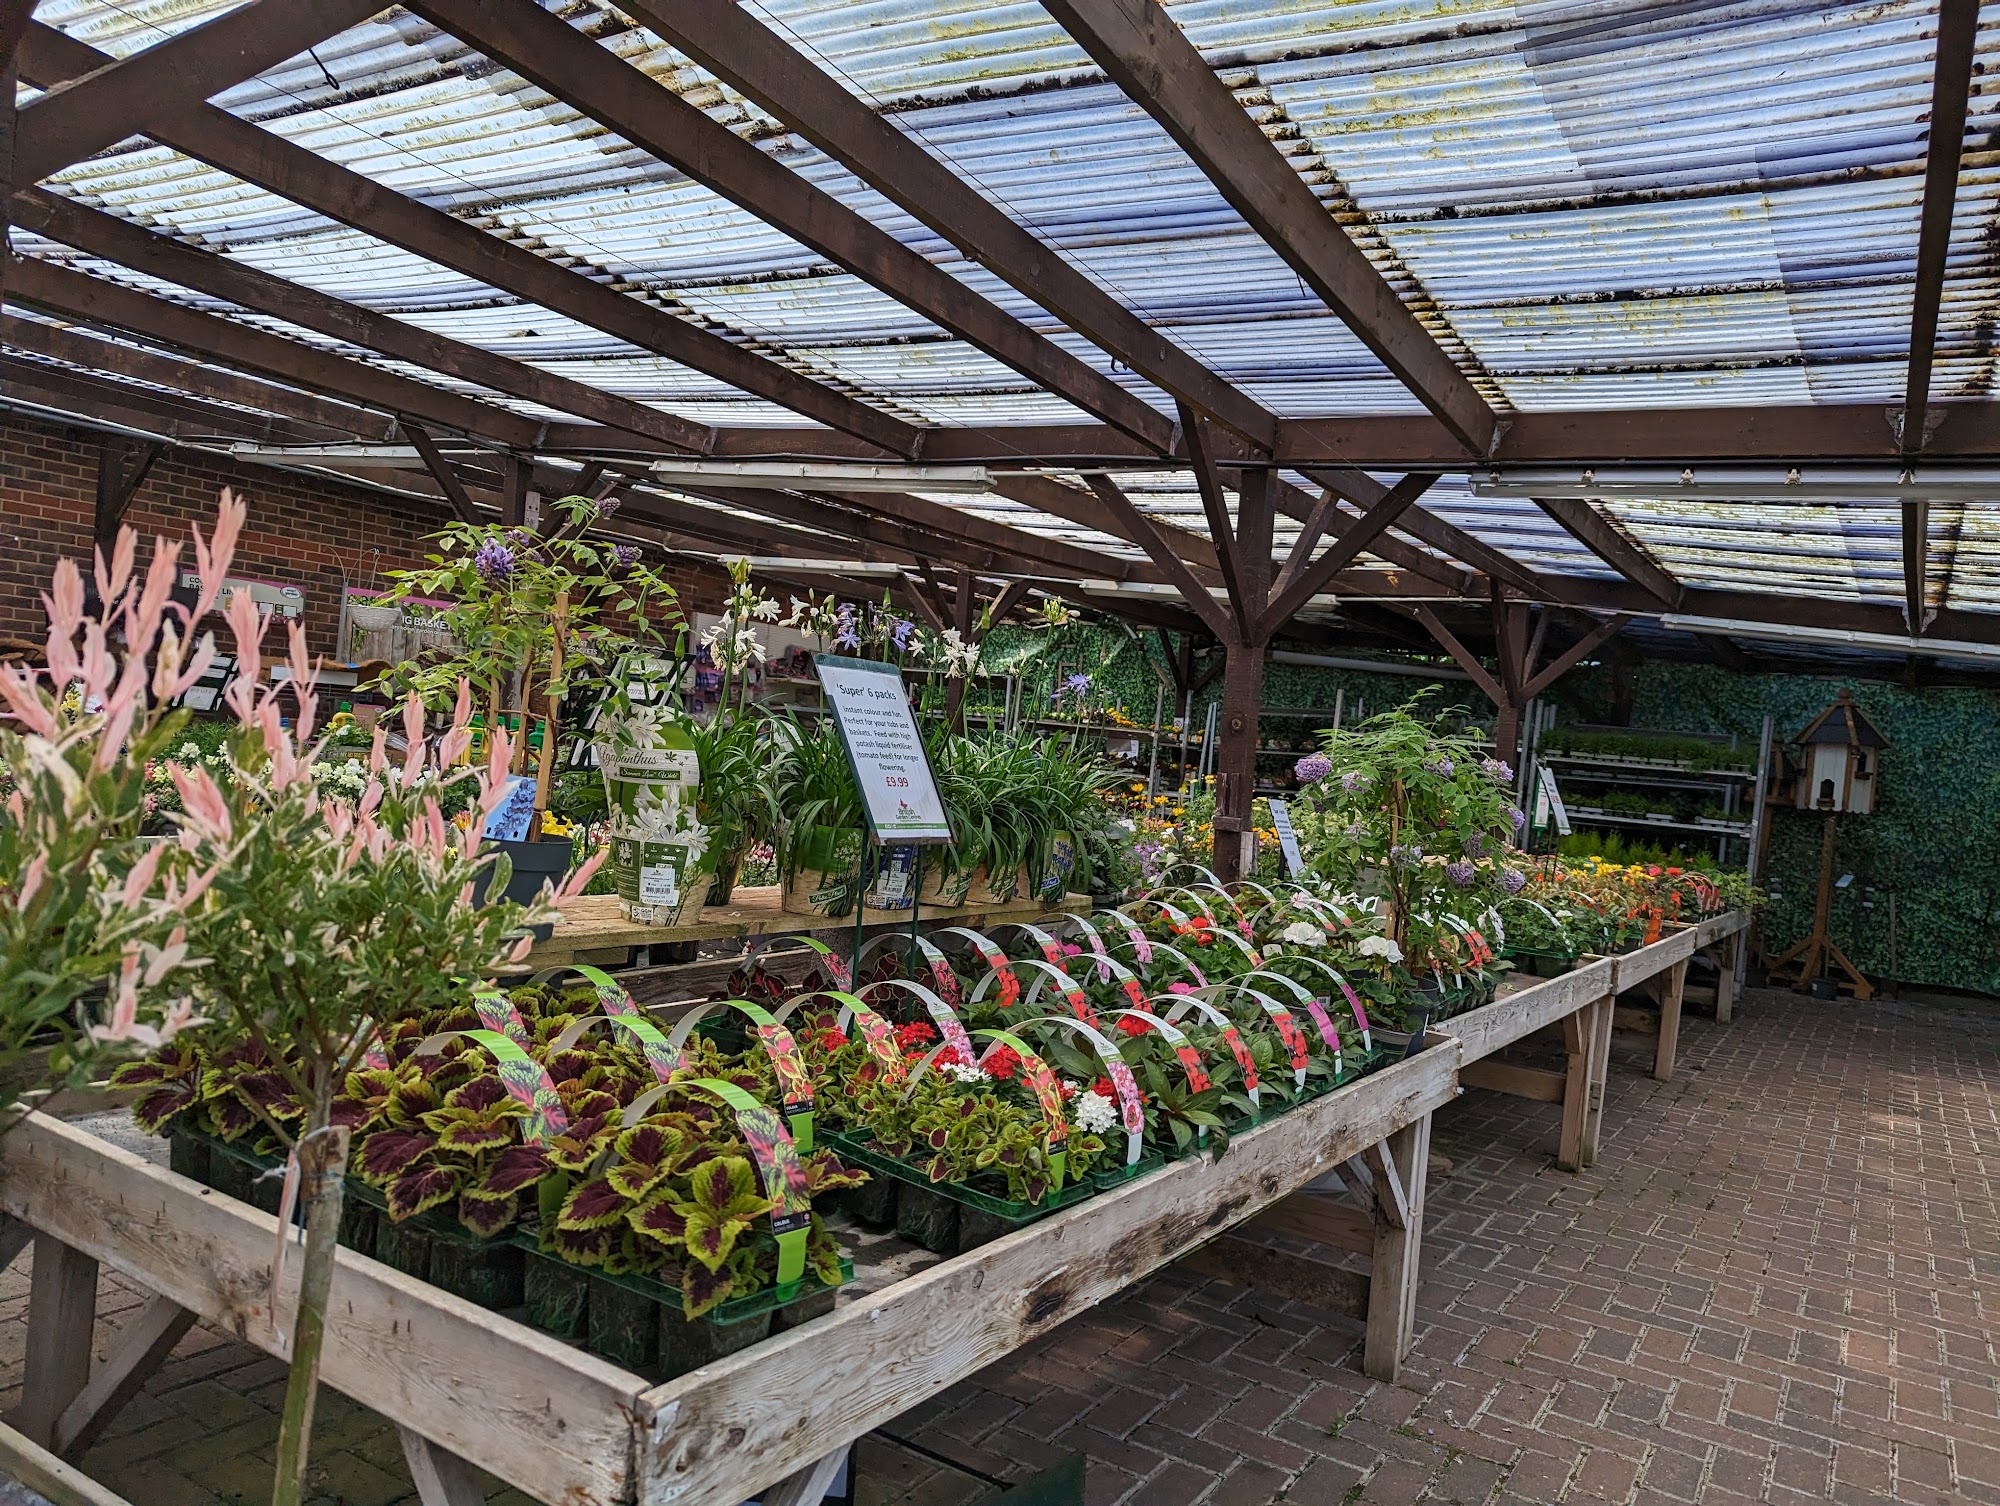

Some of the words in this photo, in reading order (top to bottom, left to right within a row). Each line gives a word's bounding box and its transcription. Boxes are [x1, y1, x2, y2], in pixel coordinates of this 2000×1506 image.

[837, 683, 864, 697] 'Super'
[867, 688, 873, 697] 6
[875, 690, 896, 700] packs
[843, 706, 863, 714] Instant
[864, 707, 880, 715] colour
[844, 716, 864, 725] Perfect
[865, 718, 873, 726] for
[874, 720, 886, 728] your
[887, 720, 899, 728] tubs
[848, 728, 872, 737] baskets.
[874, 730, 888, 738] Feed
[888, 731, 900, 739] with
[901, 731, 912, 740] high
[856, 740, 875, 748] potash
[875, 740, 891, 750] liquid
[856, 750, 879, 759] (tomato
[879, 751, 894, 761] feed)
[894, 752, 902, 760] for
[903, 753, 919, 762] longer
[886, 776, 909, 787] £9.99
